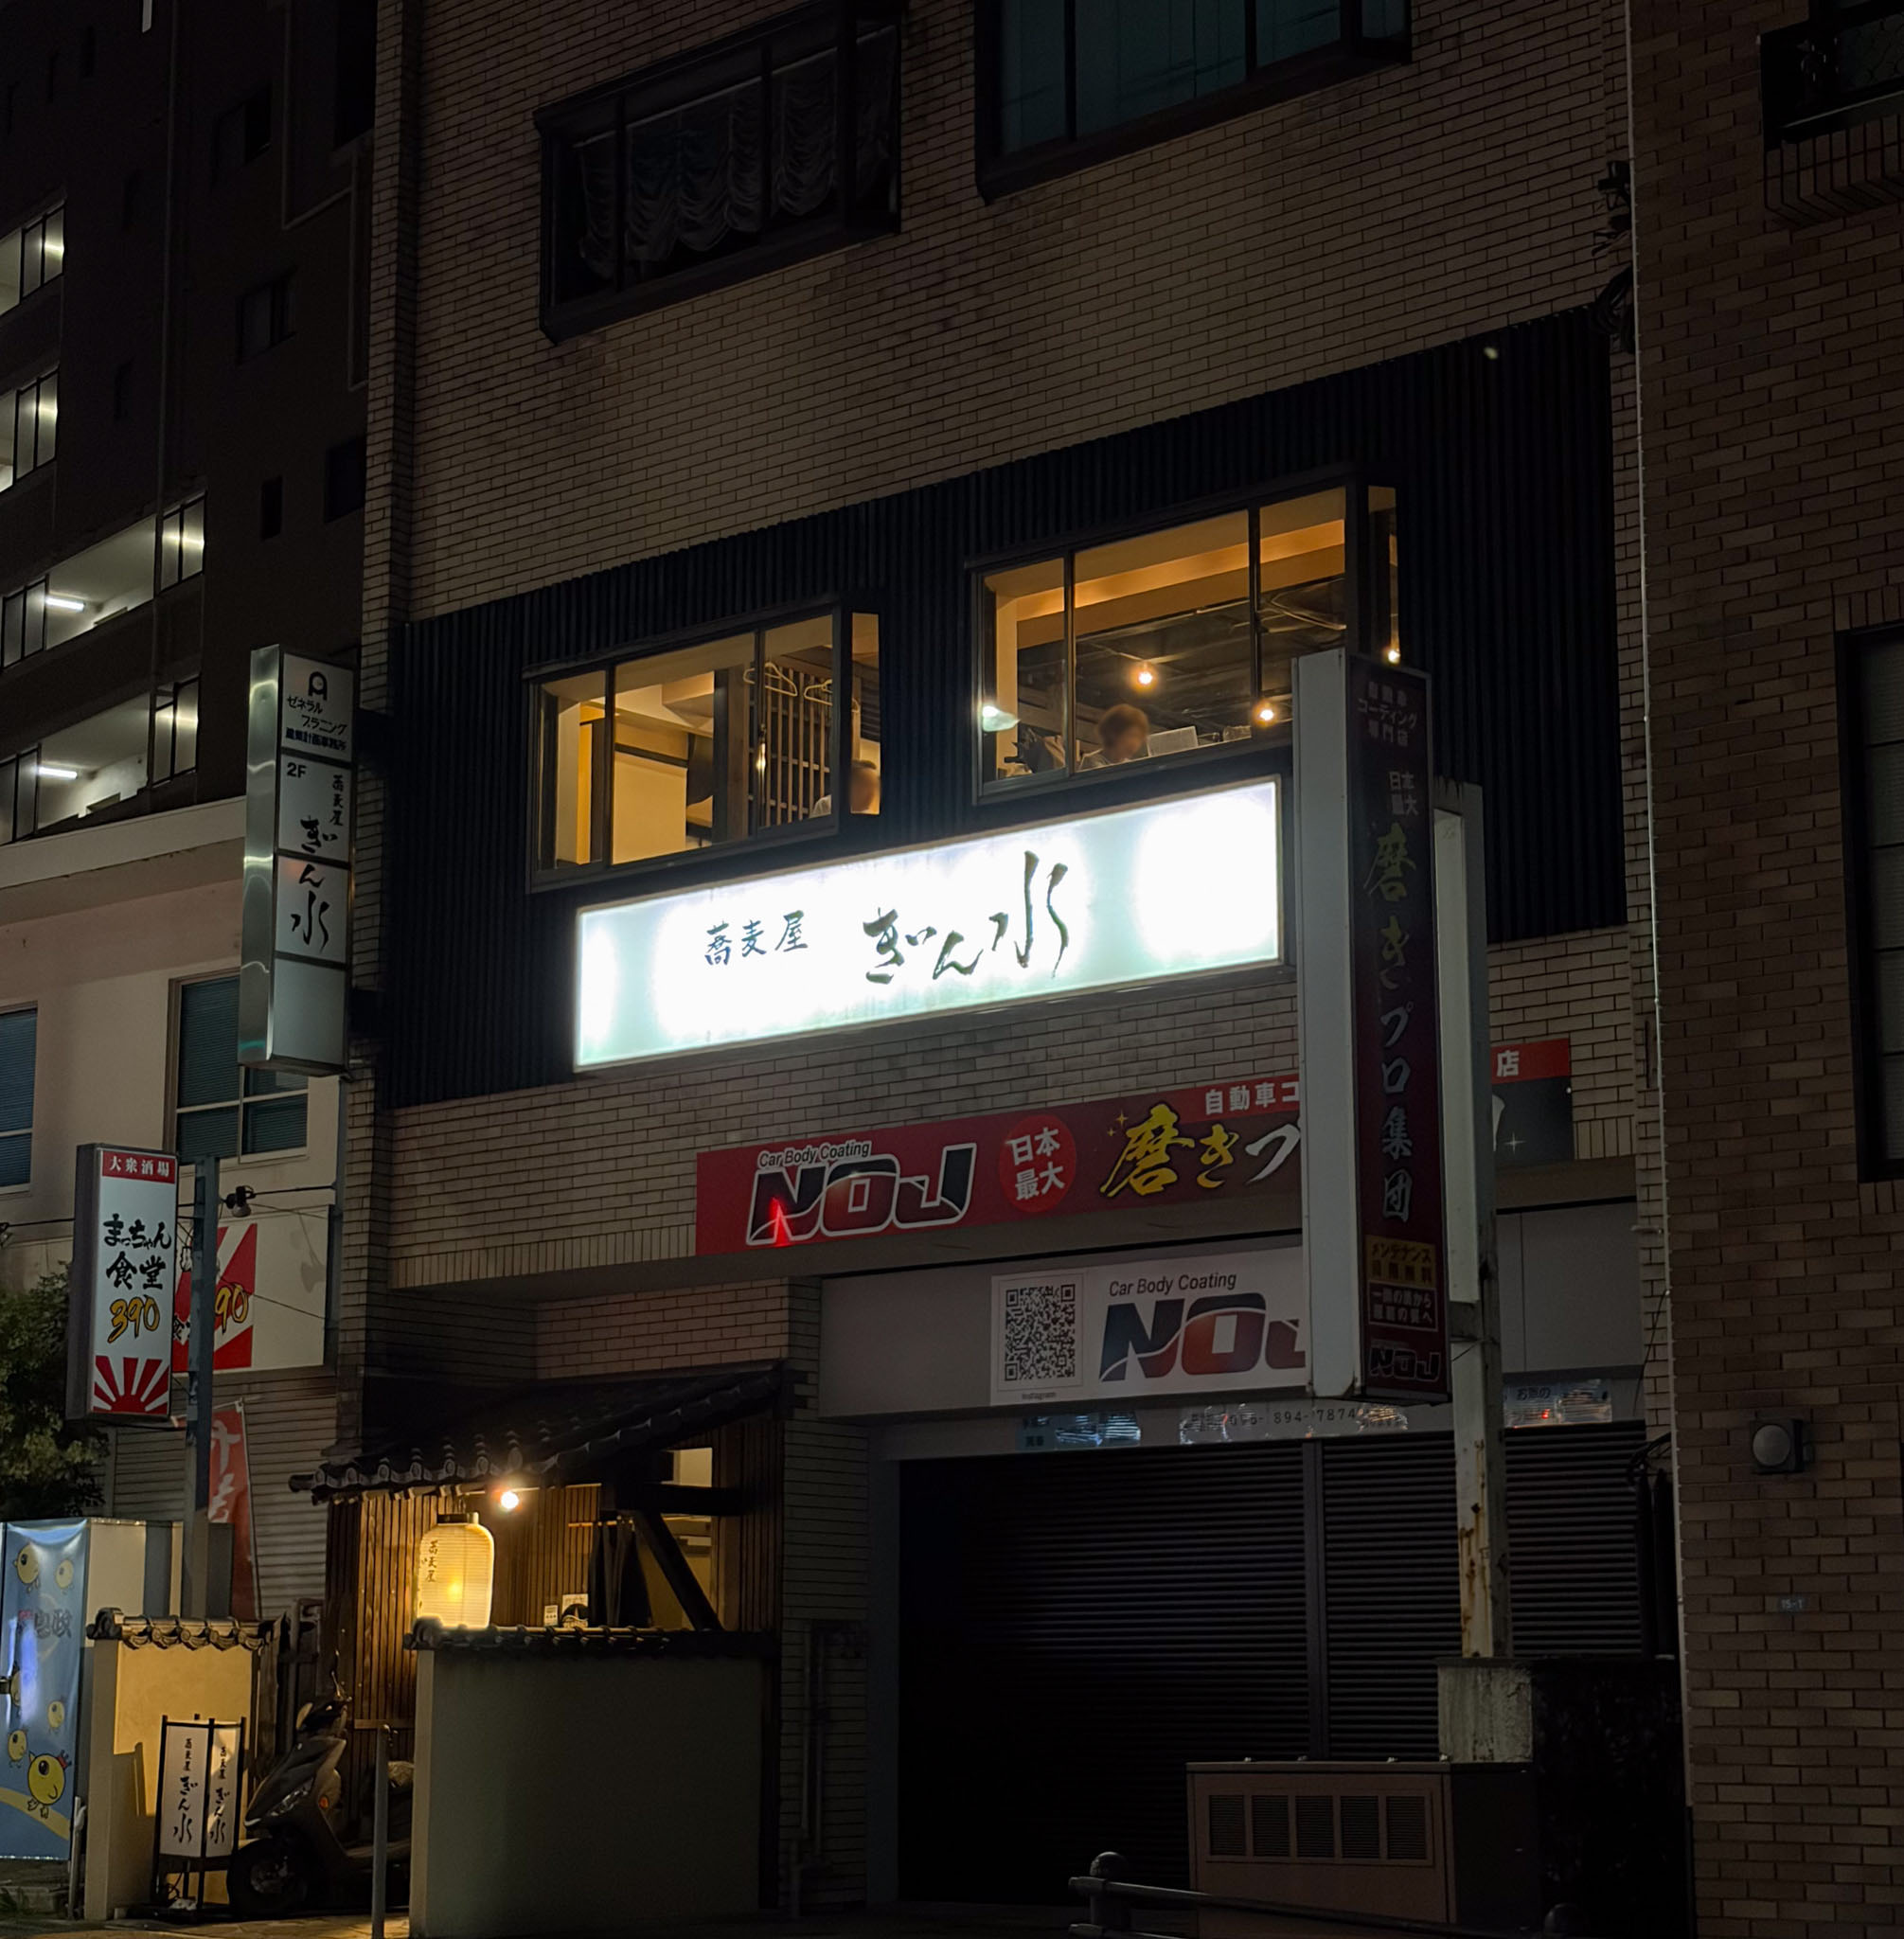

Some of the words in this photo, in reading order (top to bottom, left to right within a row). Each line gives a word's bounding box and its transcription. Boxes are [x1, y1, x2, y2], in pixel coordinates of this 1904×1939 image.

[287, 762, 307, 778] 2F
[704, 910, 809, 966] 蕎麦屋
[863, 851, 1068, 985] ぎん水
[1363, 822, 1416, 1223] 磨きプロ集団
[1204, 1082, 1300, 1115] 自動車コ
[1496, 1049, 1520, 1077] 店
[109, 1155, 169, 1177] 大衆酒場
[759, 1151, 782, 1168] Car
[784, 1147, 816, 1166] Body
[820, 1140, 871, 1160] Coating
[1008, 1127, 1060, 1166] 日本
[746, 1143, 977, 1246] NOJ
[1014, 1162, 1066, 1201] 最大
[103, 1214, 171, 1250] まっちゃん
[106, 1251, 166, 1290] 食堂
[1110, 1281, 1132, 1296] Car
[1137, 1277, 1173, 1294] Body
[1179, 1273, 1237, 1290] Coating
[107, 1295, 160, 1343] 390
